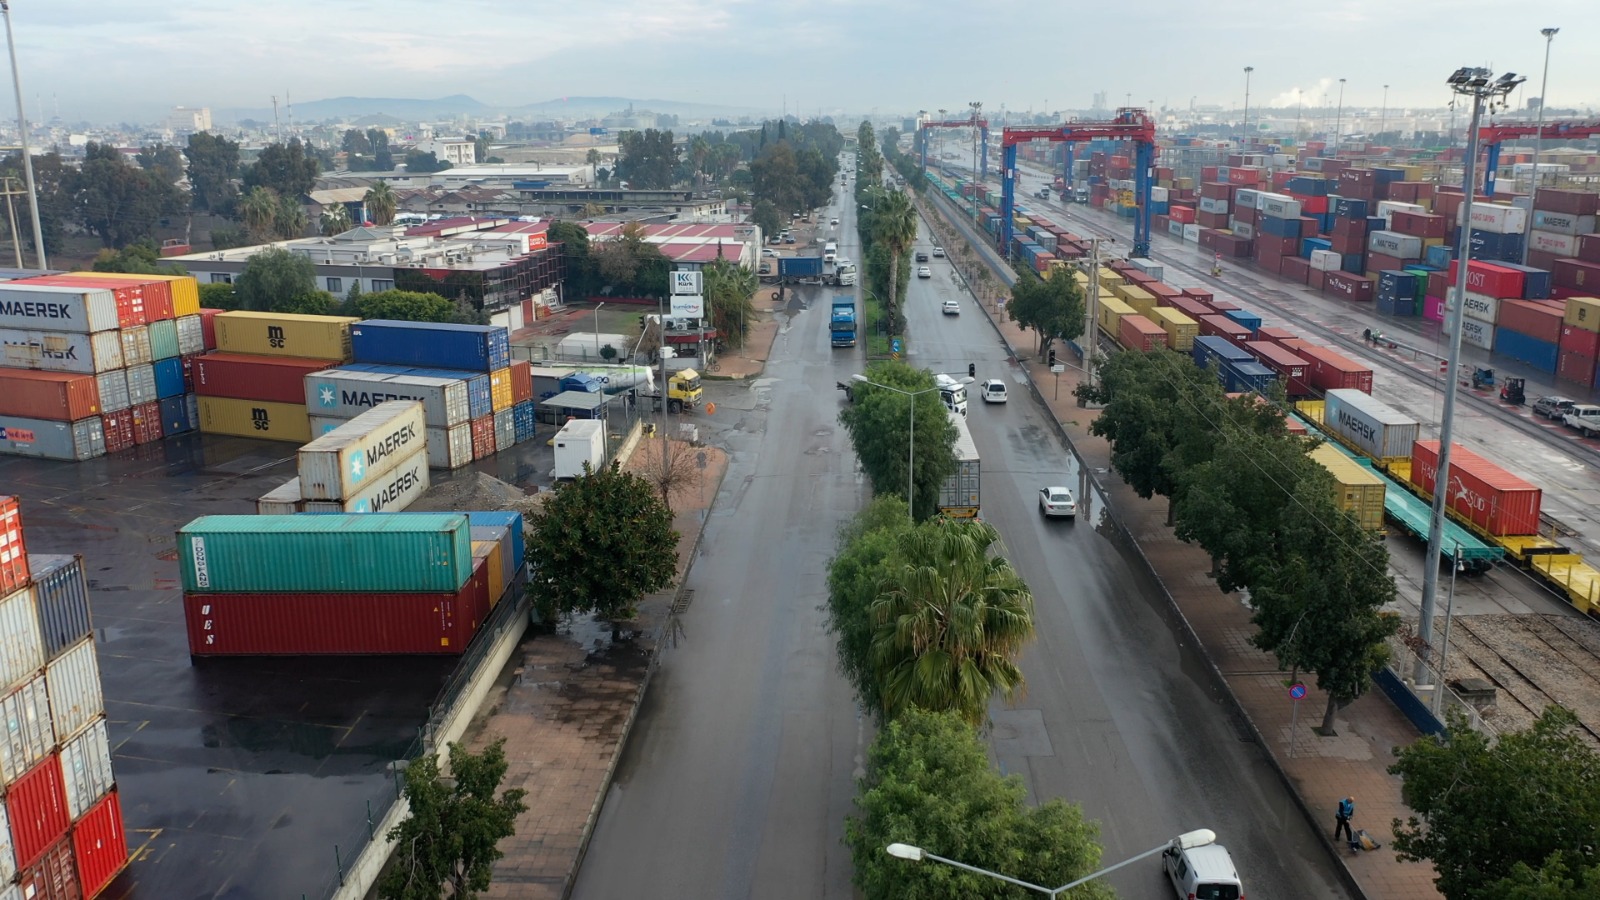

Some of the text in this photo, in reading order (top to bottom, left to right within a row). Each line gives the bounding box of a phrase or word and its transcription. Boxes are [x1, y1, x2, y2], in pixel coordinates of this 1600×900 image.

[0, 301, 71, 319] MAERSK
[1464, 297, 1490, 313] AERSK
[1462, 321, 1483, 335] AERSK
[1338, 410, 1376, 444] MAERSK
[366, 421, 416, 467] MAERSK
[371, 466, 419, 513] MAERSK
